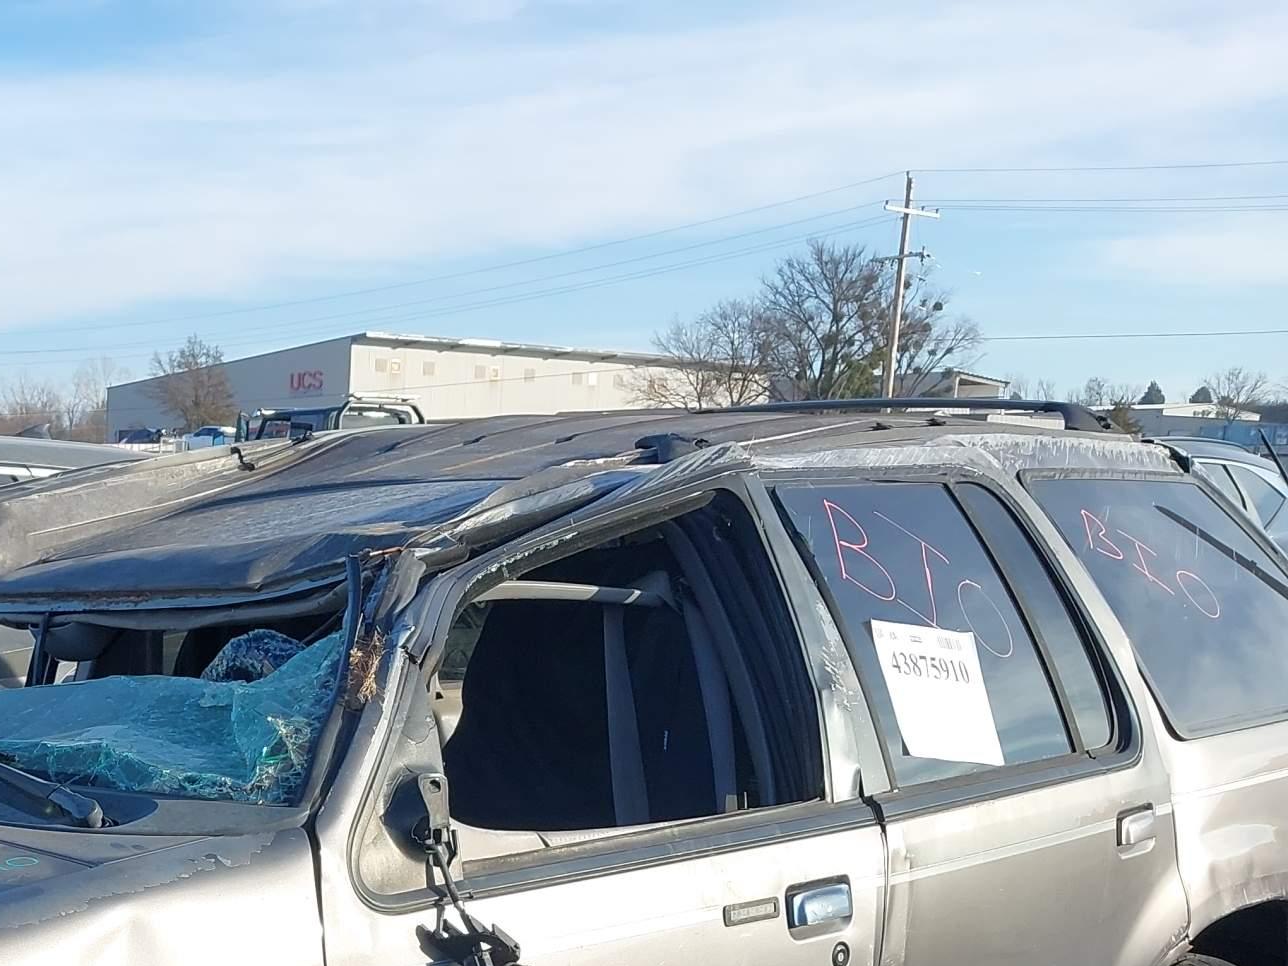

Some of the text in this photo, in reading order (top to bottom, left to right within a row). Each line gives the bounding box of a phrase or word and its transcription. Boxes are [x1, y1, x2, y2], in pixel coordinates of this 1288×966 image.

[289, 370, 324, 391] UCS
[1080, 508, 1221, 619] BIO
[890, 650, 970, 684] 43875910
